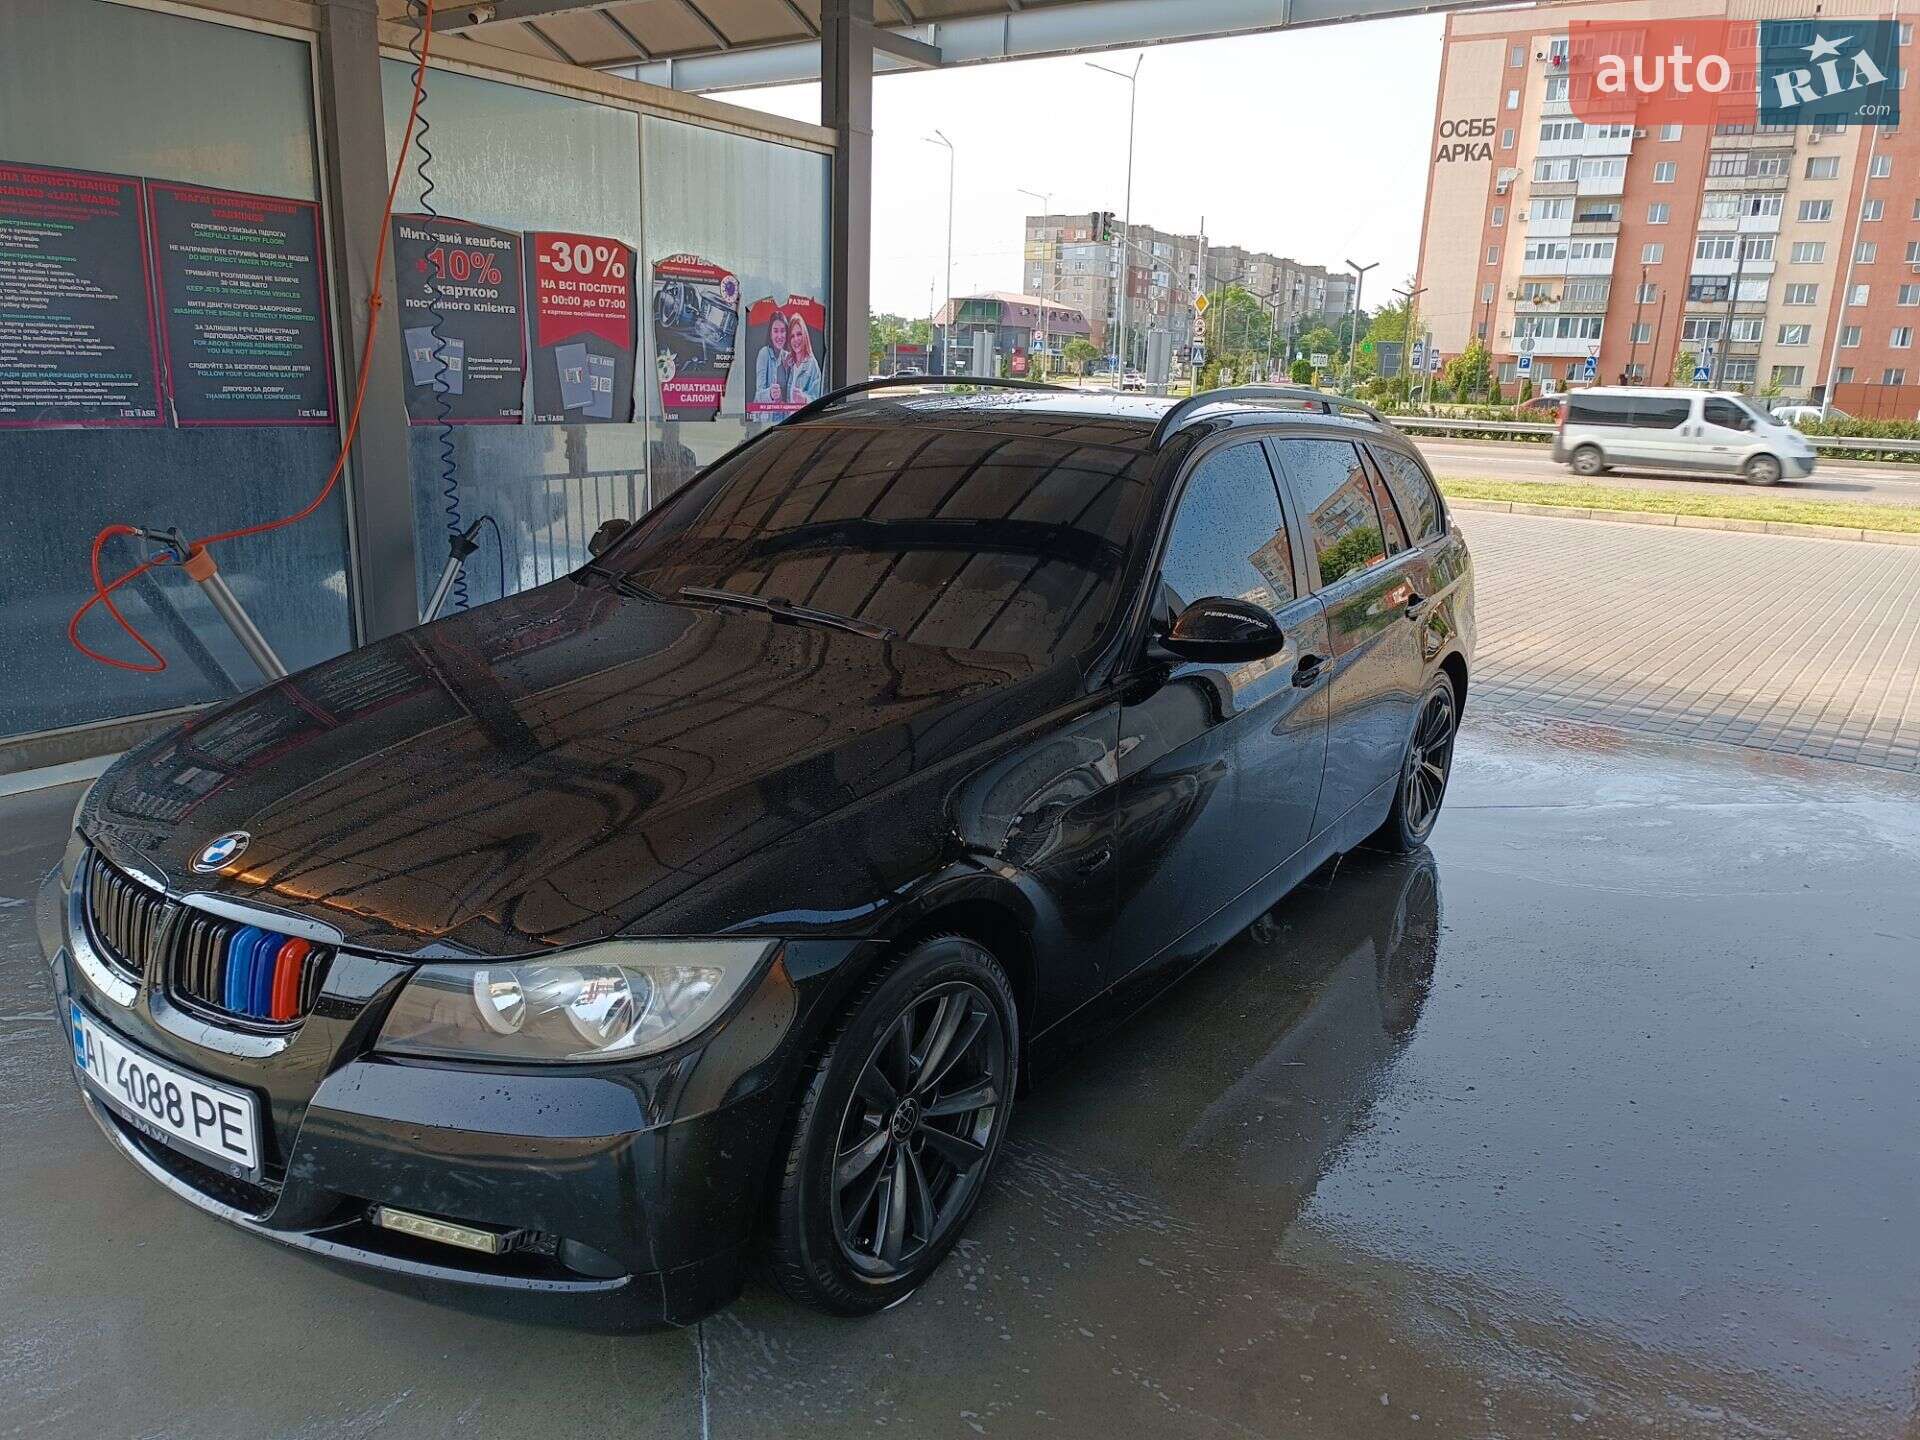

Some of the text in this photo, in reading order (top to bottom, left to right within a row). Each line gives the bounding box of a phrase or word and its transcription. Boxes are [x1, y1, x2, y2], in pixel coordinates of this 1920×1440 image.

[1439, 118, 1496, 139] ОСББ
[1436, 142, 1494, 163] АРКА
[465, 238, 512, 250] кешбек
[214, 256, 238, 264] DIRECT
[270, 261, 294, 269] PEOPLE
[540, 242, 625, 278] -30%
[437, 284, 498, 299] карткою
[541, 279, 625, 294] НА ВСІ ПОСЛУГИ
[474, 302, 516, 314] клієнта
[552, 295, 580, 305] 00:00
[583, 299, 595, 308] до
[598, 298, 625, 309] 07:00
[680, 394, 715, 402] САЛОНУ
[1204, 610, 1269, 629] PERFORMANCE
[86, 1028, 247, 1156] AI 4088 PE
